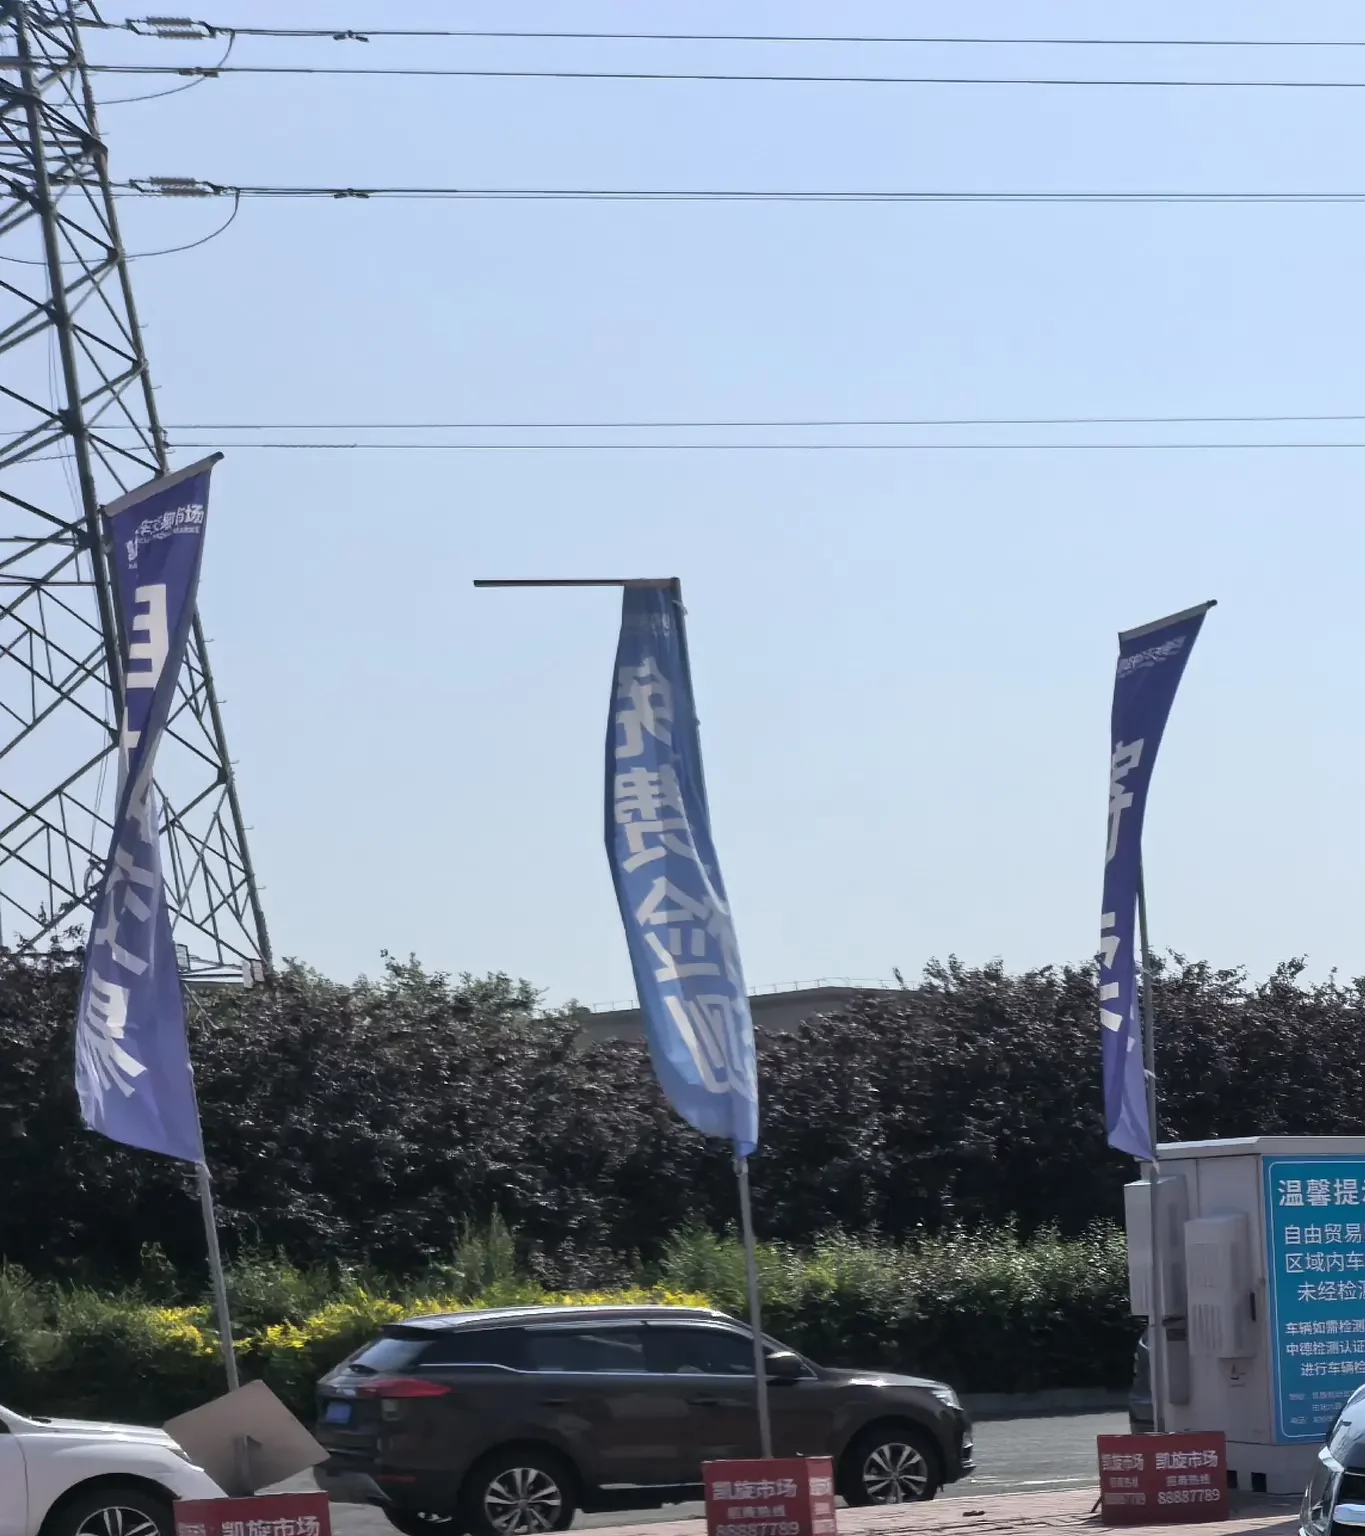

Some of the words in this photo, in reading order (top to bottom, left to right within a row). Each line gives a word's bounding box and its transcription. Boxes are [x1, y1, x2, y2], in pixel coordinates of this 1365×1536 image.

[1155, 1450, 1218, 1469] 凯旋市场
[1157, 1489, 1221, 1505] 88887789
